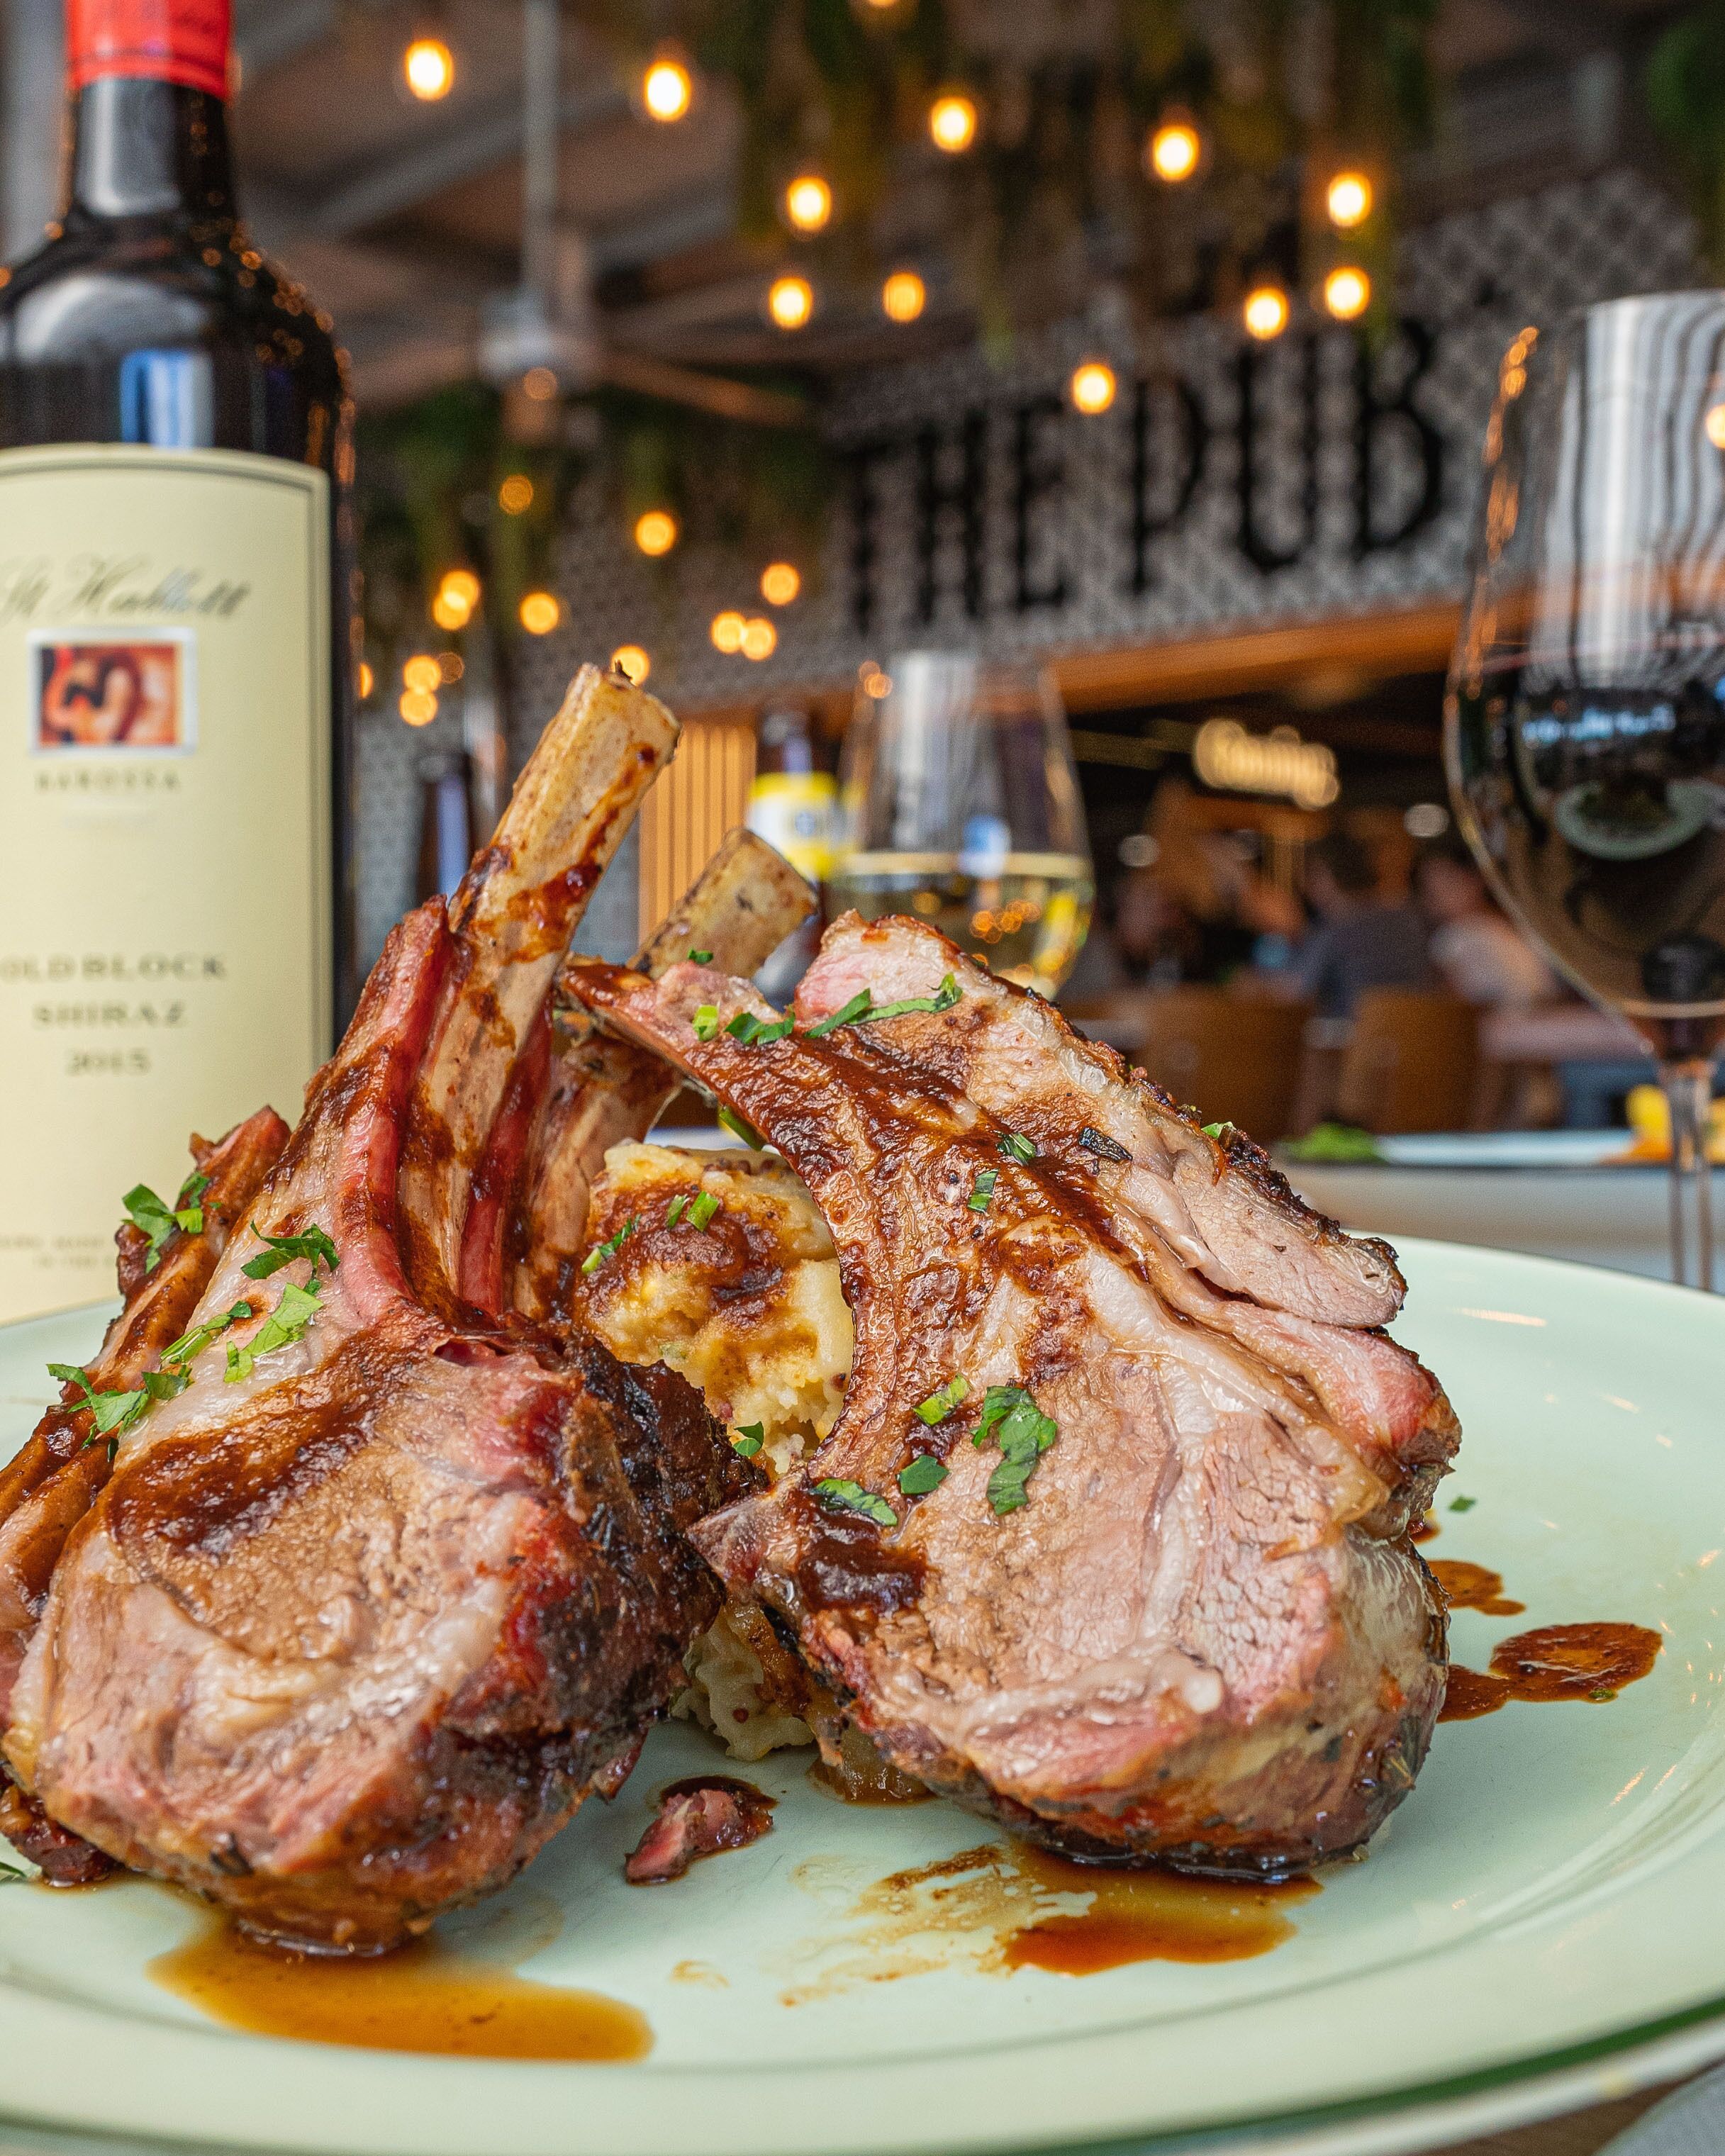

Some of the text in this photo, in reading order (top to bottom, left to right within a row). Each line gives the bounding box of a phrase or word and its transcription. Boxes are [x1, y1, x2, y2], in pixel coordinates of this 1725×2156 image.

[839, 318, 1444, 635] THE PUB
[81, 951, 228, 983] BLOCK
[31, 999, 188, 1030] SHIRAZ
